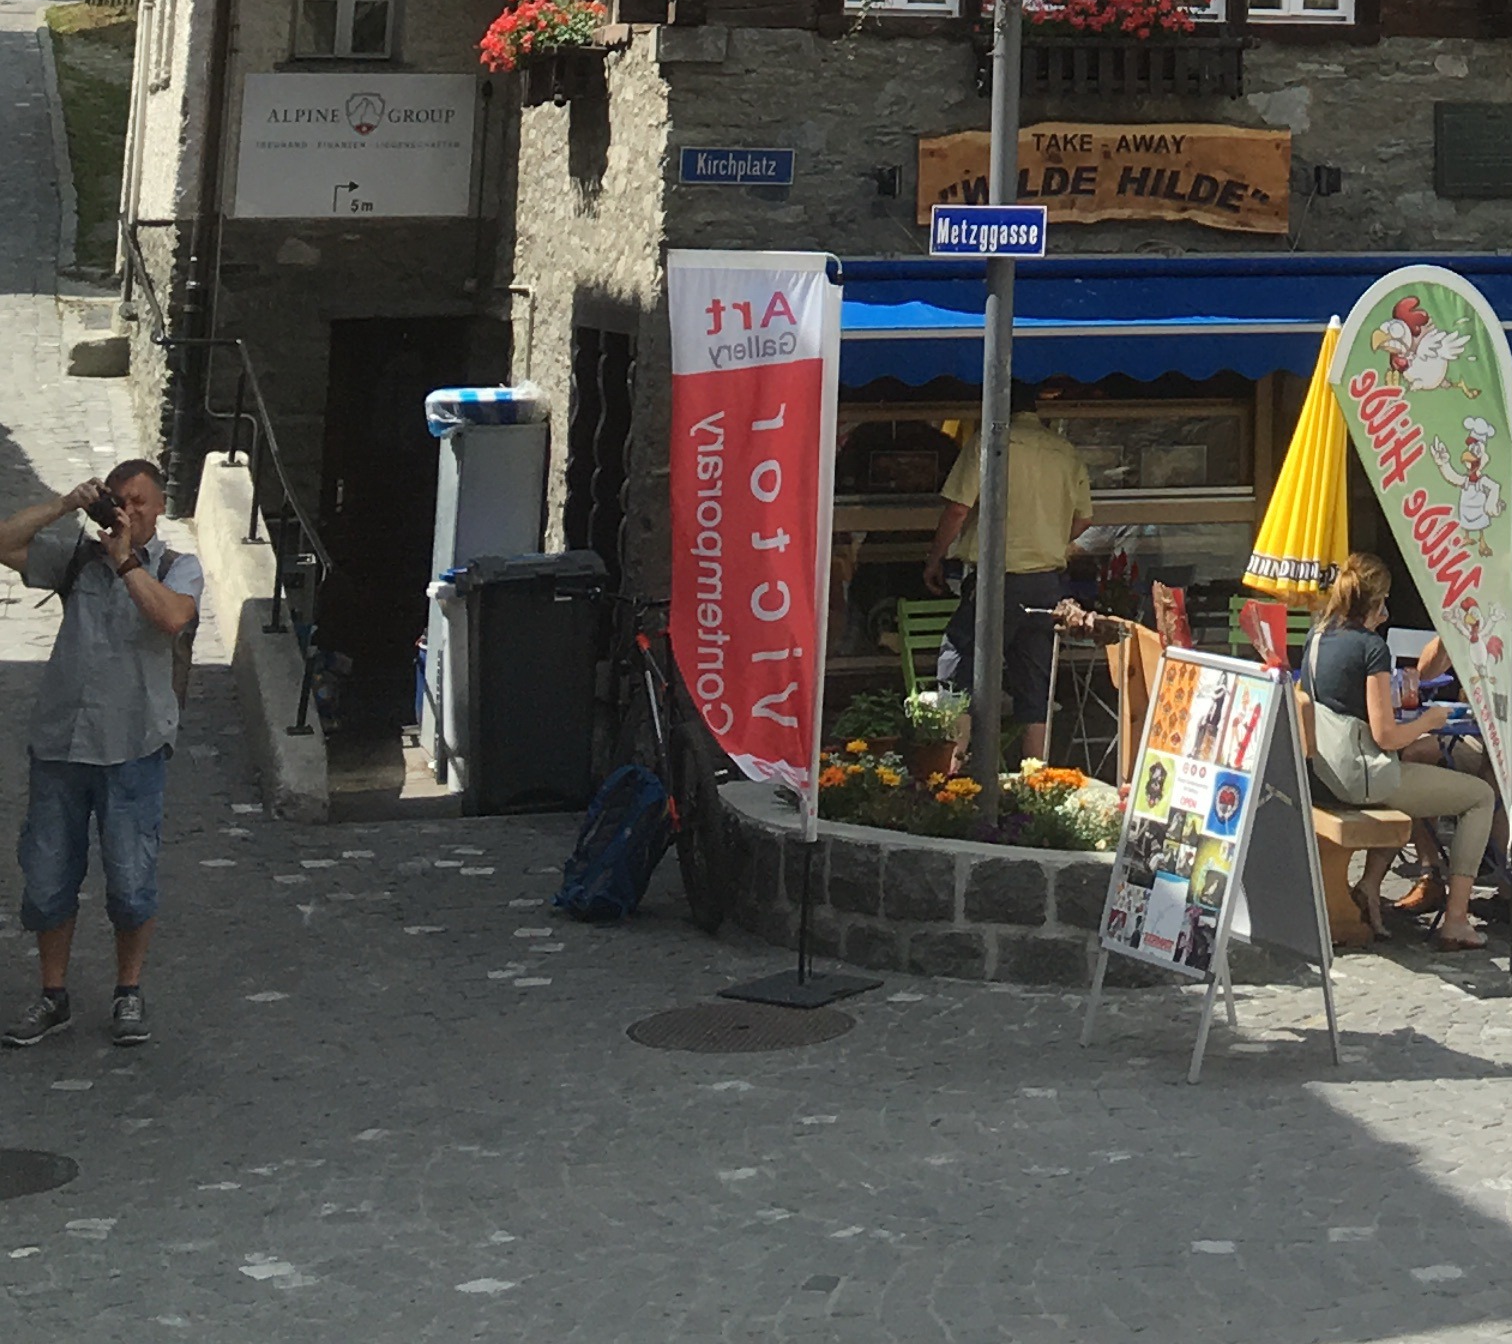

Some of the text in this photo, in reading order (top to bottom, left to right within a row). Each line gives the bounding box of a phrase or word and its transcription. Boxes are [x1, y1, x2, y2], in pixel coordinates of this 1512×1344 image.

[267, 109, 456, 124] ALPINE GROUP
[1032, 133, 1092, 153] TAKE
[1116, 134, 1187, 154] AWAY
[697, 153, 777, 182] Kirchplatz
[938, 165, 1099, 206] "WLDE
[937, 217, 1038, 252] Metzggasse
